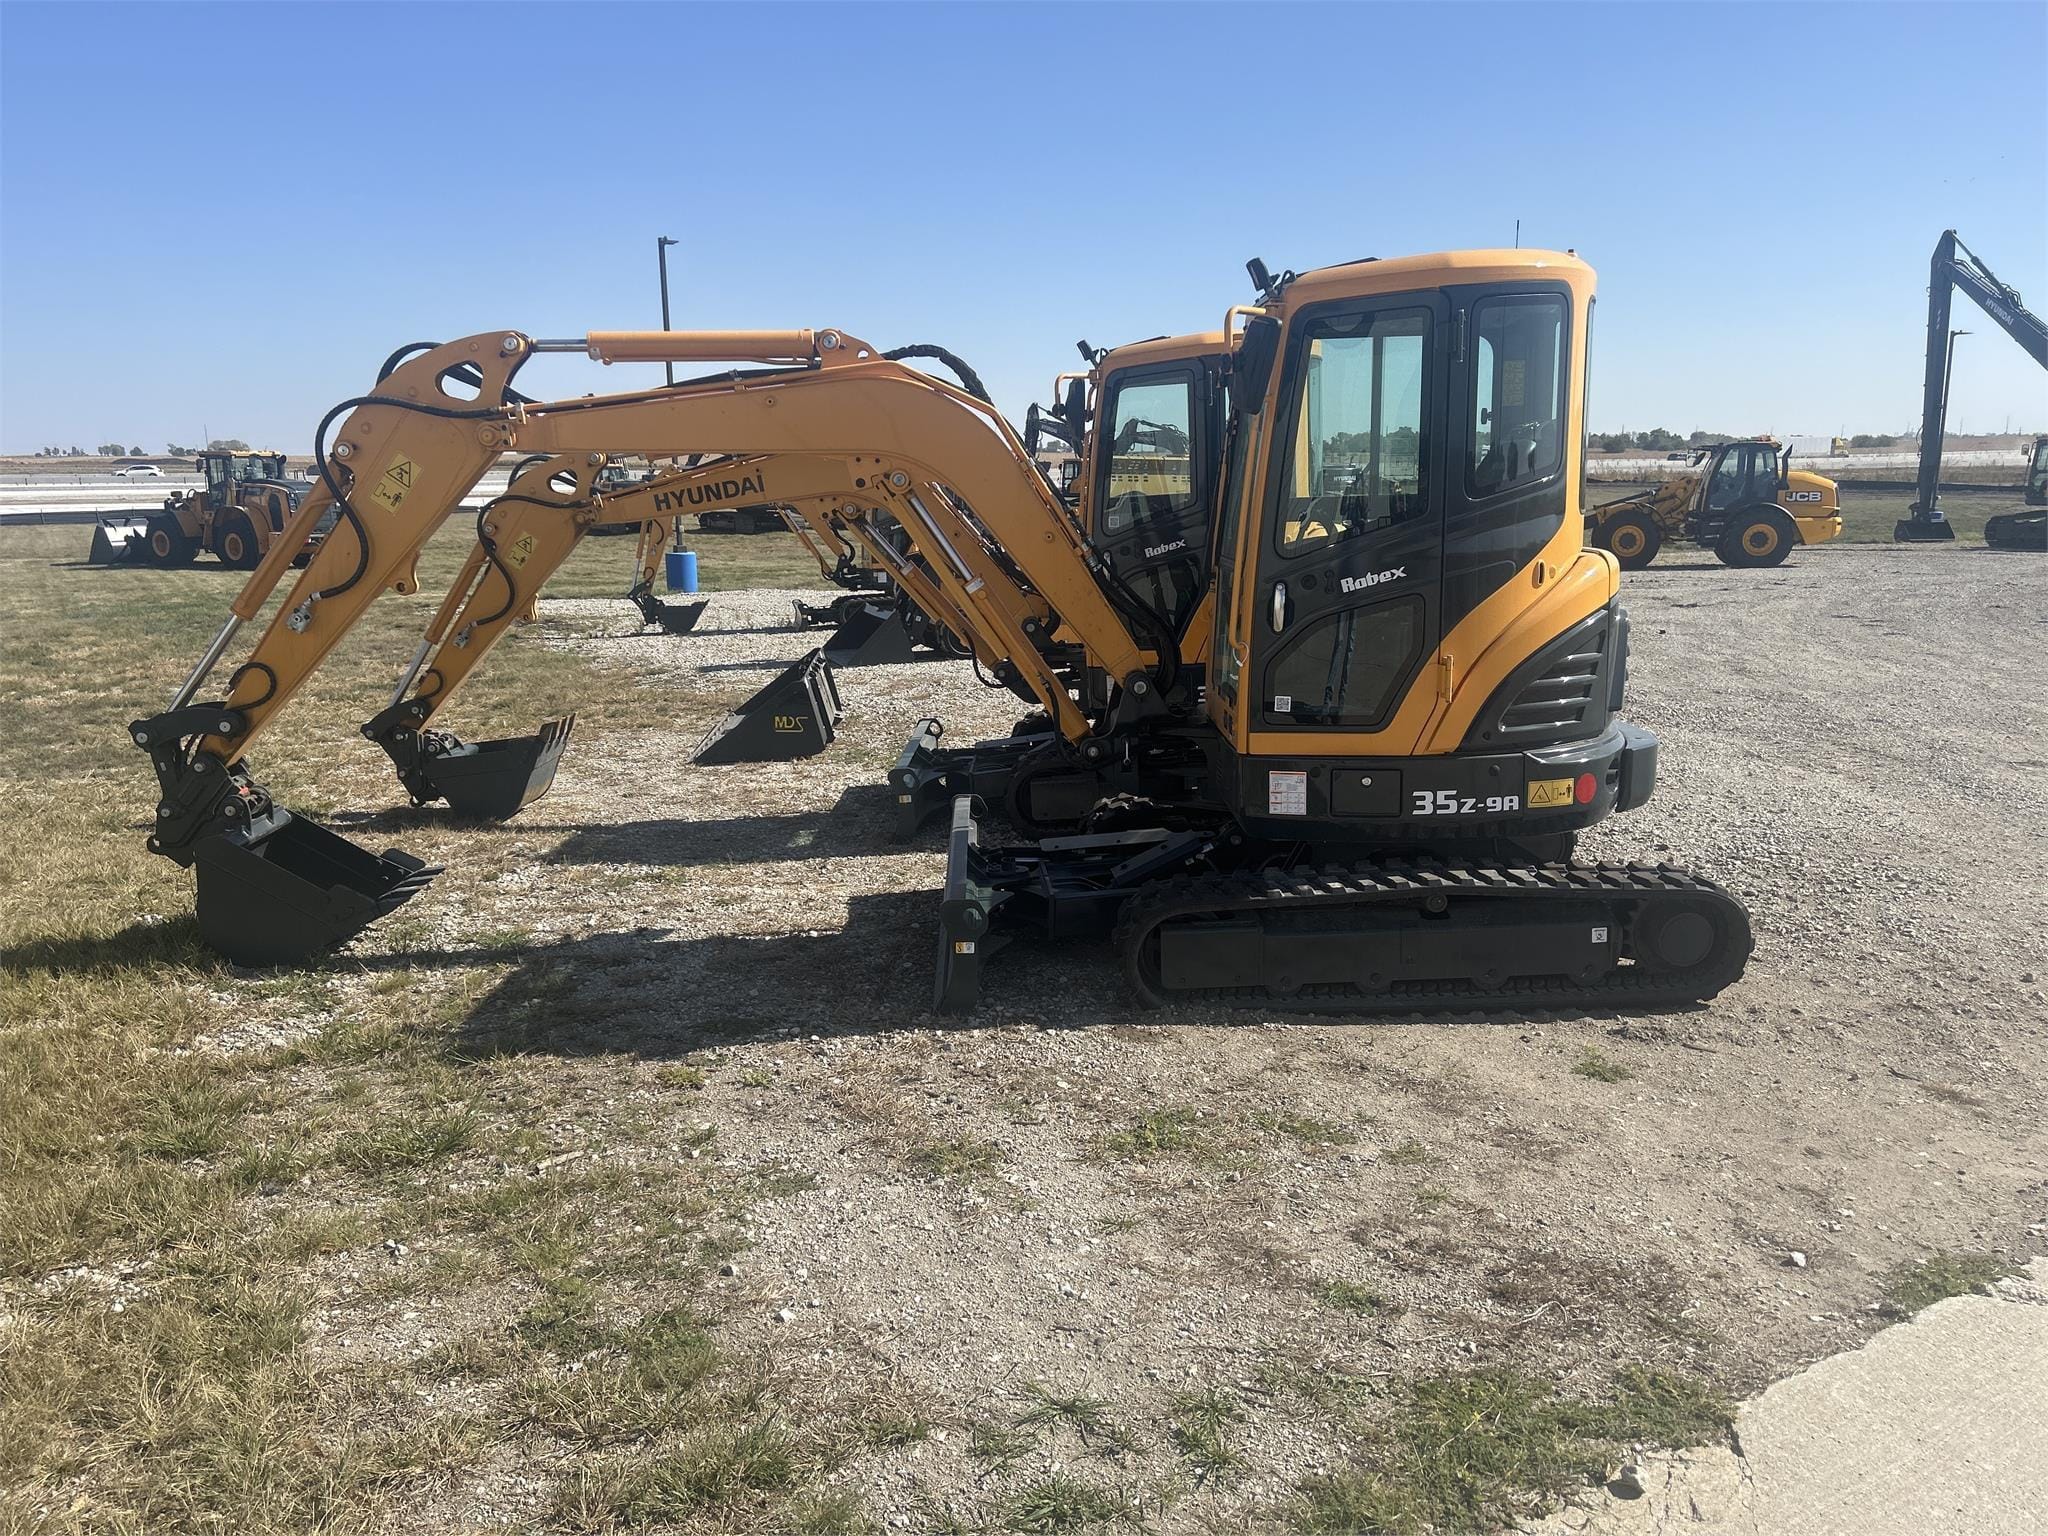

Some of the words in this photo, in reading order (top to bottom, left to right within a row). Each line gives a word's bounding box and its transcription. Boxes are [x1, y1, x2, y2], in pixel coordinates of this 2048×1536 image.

[1985, 298, 2014, 326] HYUNDAI
[653, 474, 765, 512] HYUNDAI
[1785, 491, 1822, 502] JCB
[1144, 539, 1186, 558] Robex
[1340, 566, 1407, 593] Robex
[774, 716, 808, 733] MDS
